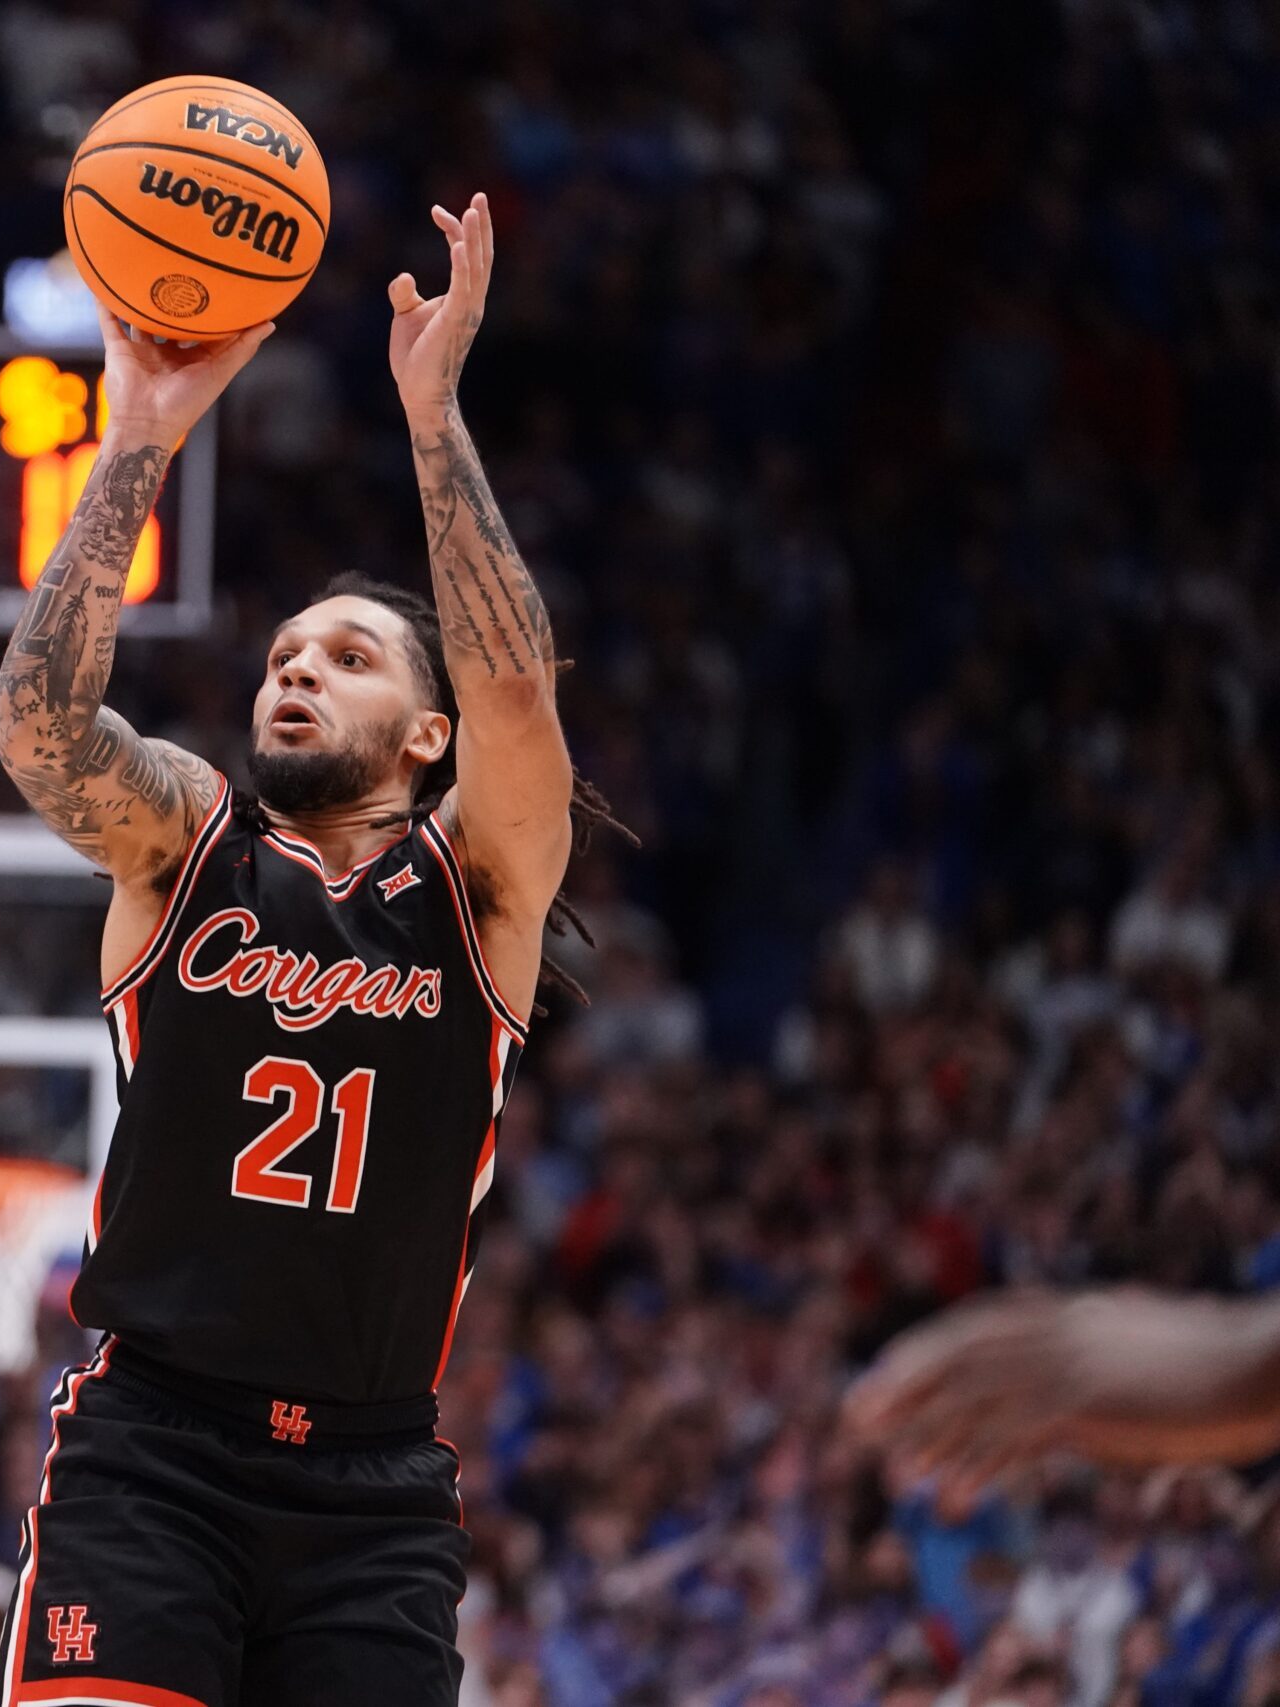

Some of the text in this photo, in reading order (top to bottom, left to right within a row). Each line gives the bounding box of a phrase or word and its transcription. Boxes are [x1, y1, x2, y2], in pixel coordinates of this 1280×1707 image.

[185, 103, 304, 170] NCAA
[138, 163, 300, 264] Wilson
[178, 906, 442, 1032] Cougars
[231, 1055, 376, 1214] 21
[270, 1399, 312, 1445] UH
[47, 1604, 97, 1663] UH
